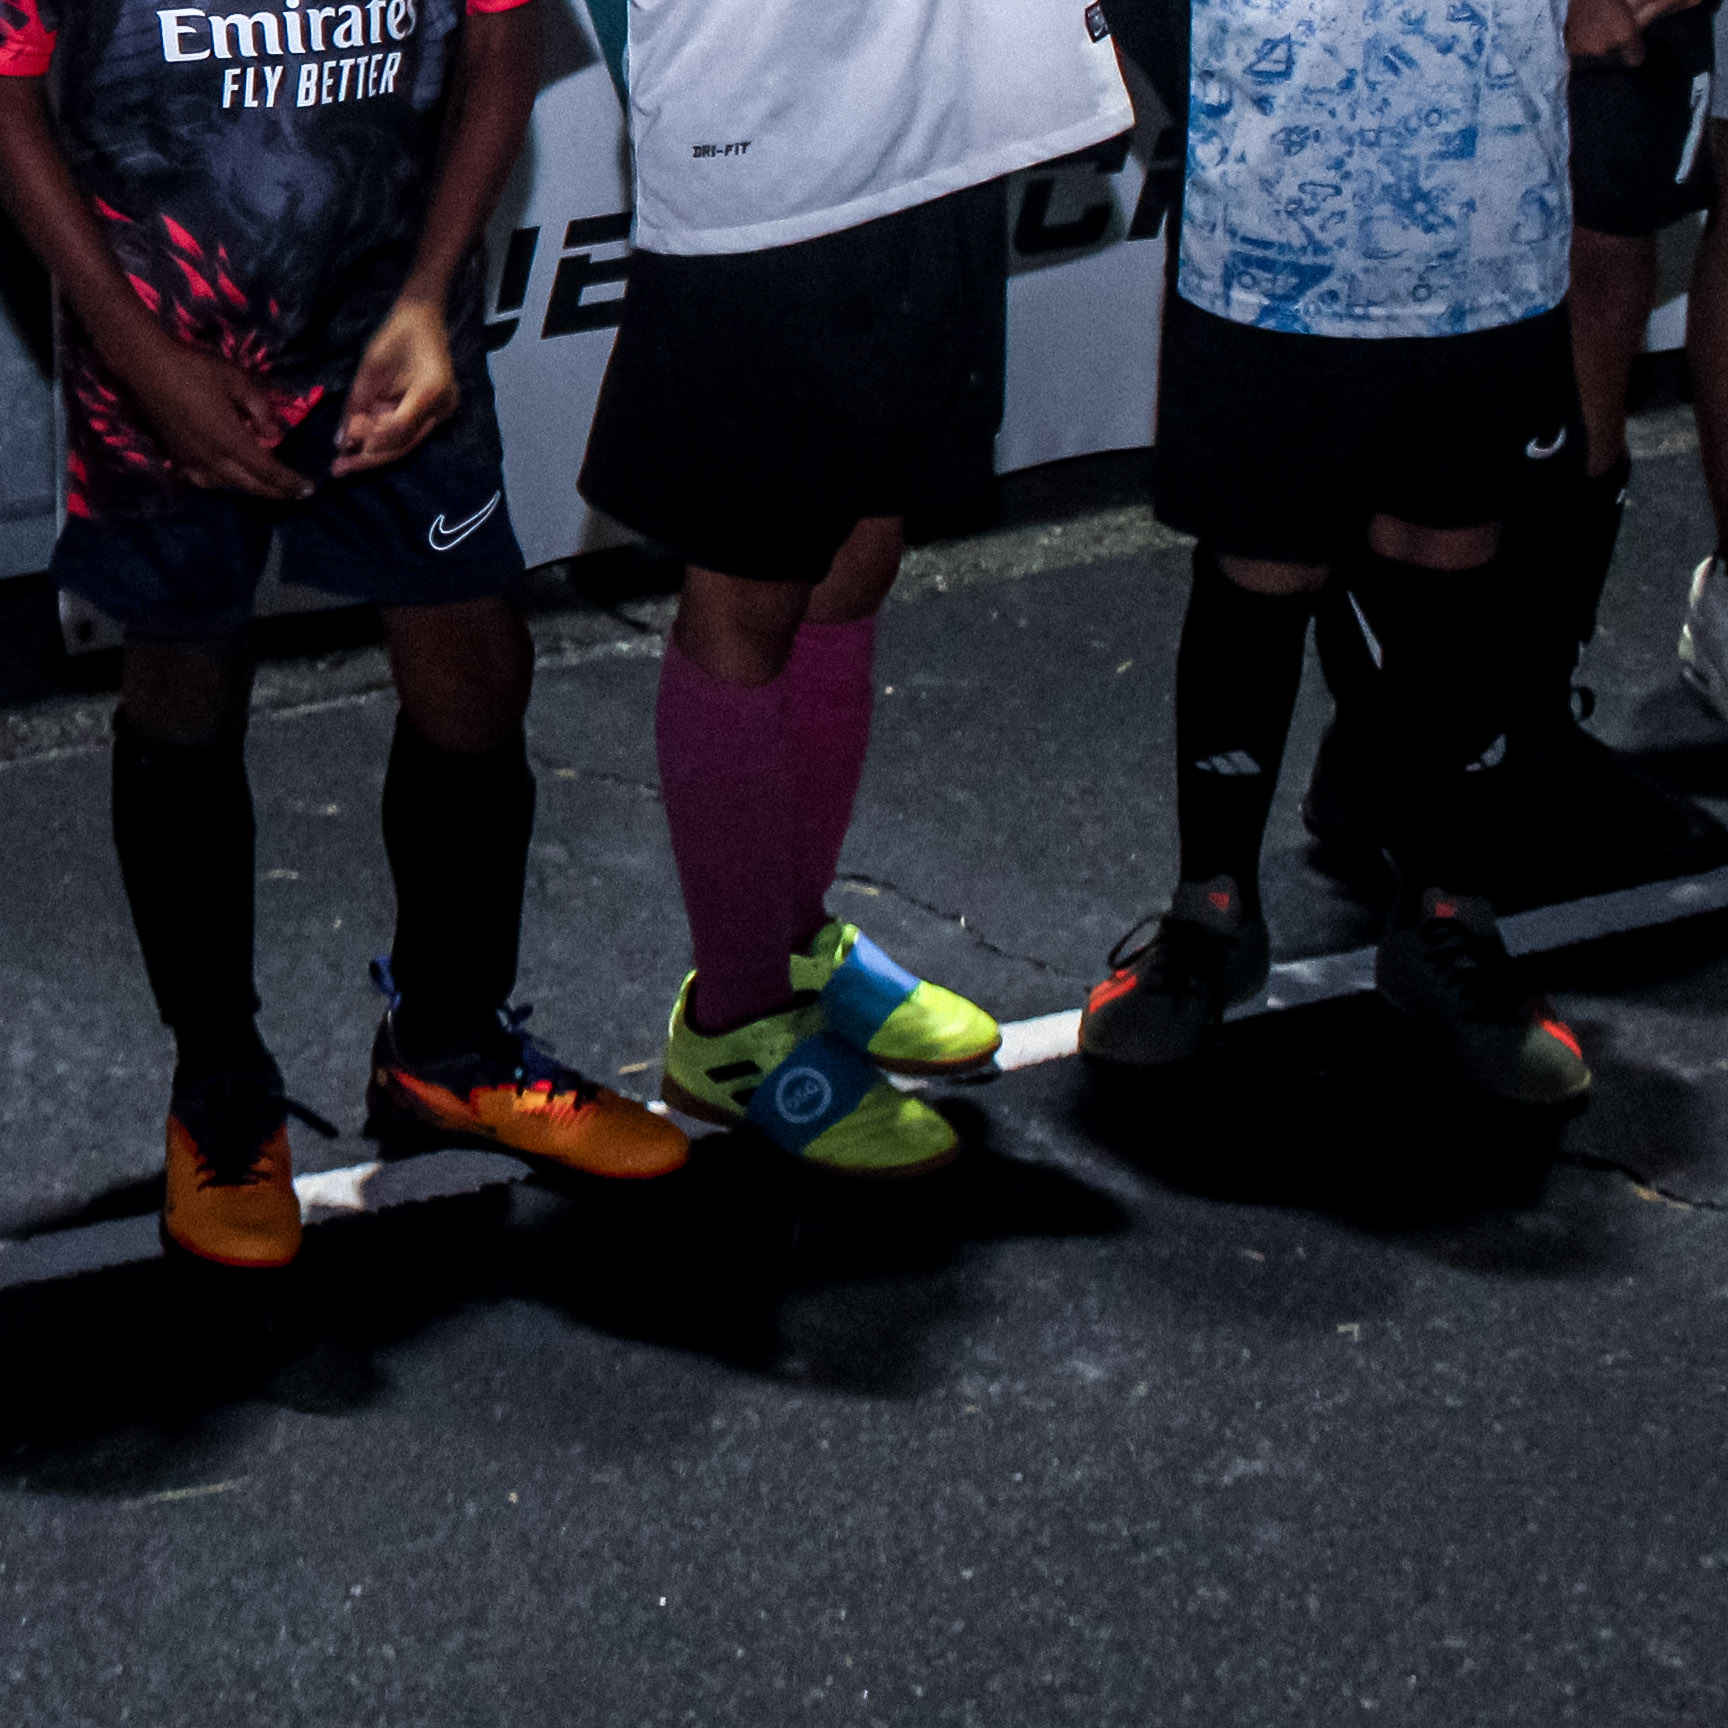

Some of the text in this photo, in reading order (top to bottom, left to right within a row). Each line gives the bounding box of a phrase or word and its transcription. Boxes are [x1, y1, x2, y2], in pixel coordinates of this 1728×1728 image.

[222, 51, 403, 109] FLY BETTER
[692, 140, 752, 159] DRI-FIT
